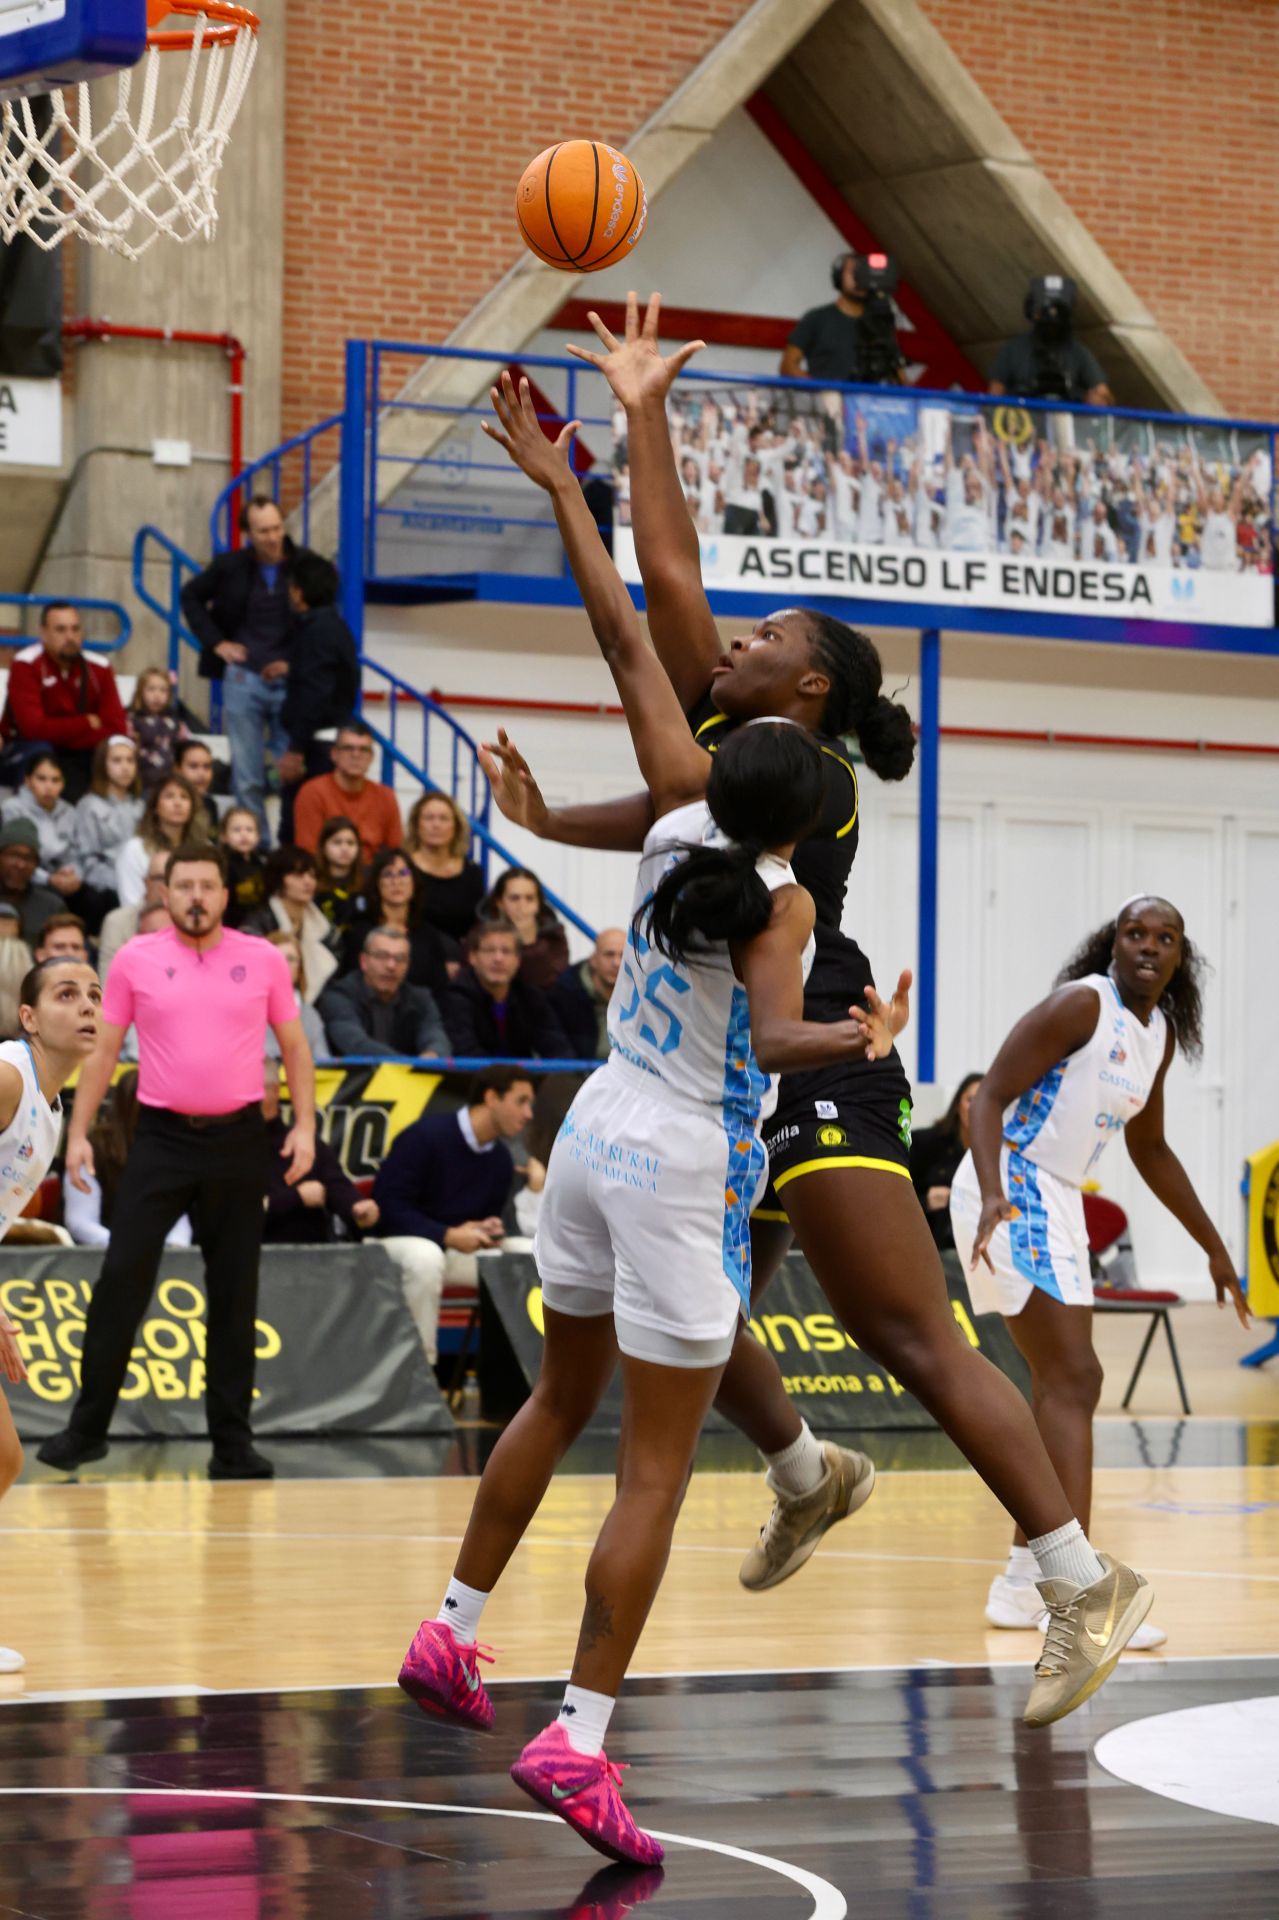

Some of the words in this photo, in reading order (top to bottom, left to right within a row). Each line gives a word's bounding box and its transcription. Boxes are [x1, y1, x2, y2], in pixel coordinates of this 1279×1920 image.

[739, 546, 926, 588] ASCENSO
[942, 559, 986, 591] LF
[1002, 563, 1153, 604] ENDESA
[0, 1279, 206, 1320] GRO
[781, 1374, 863, 1394] ersona
